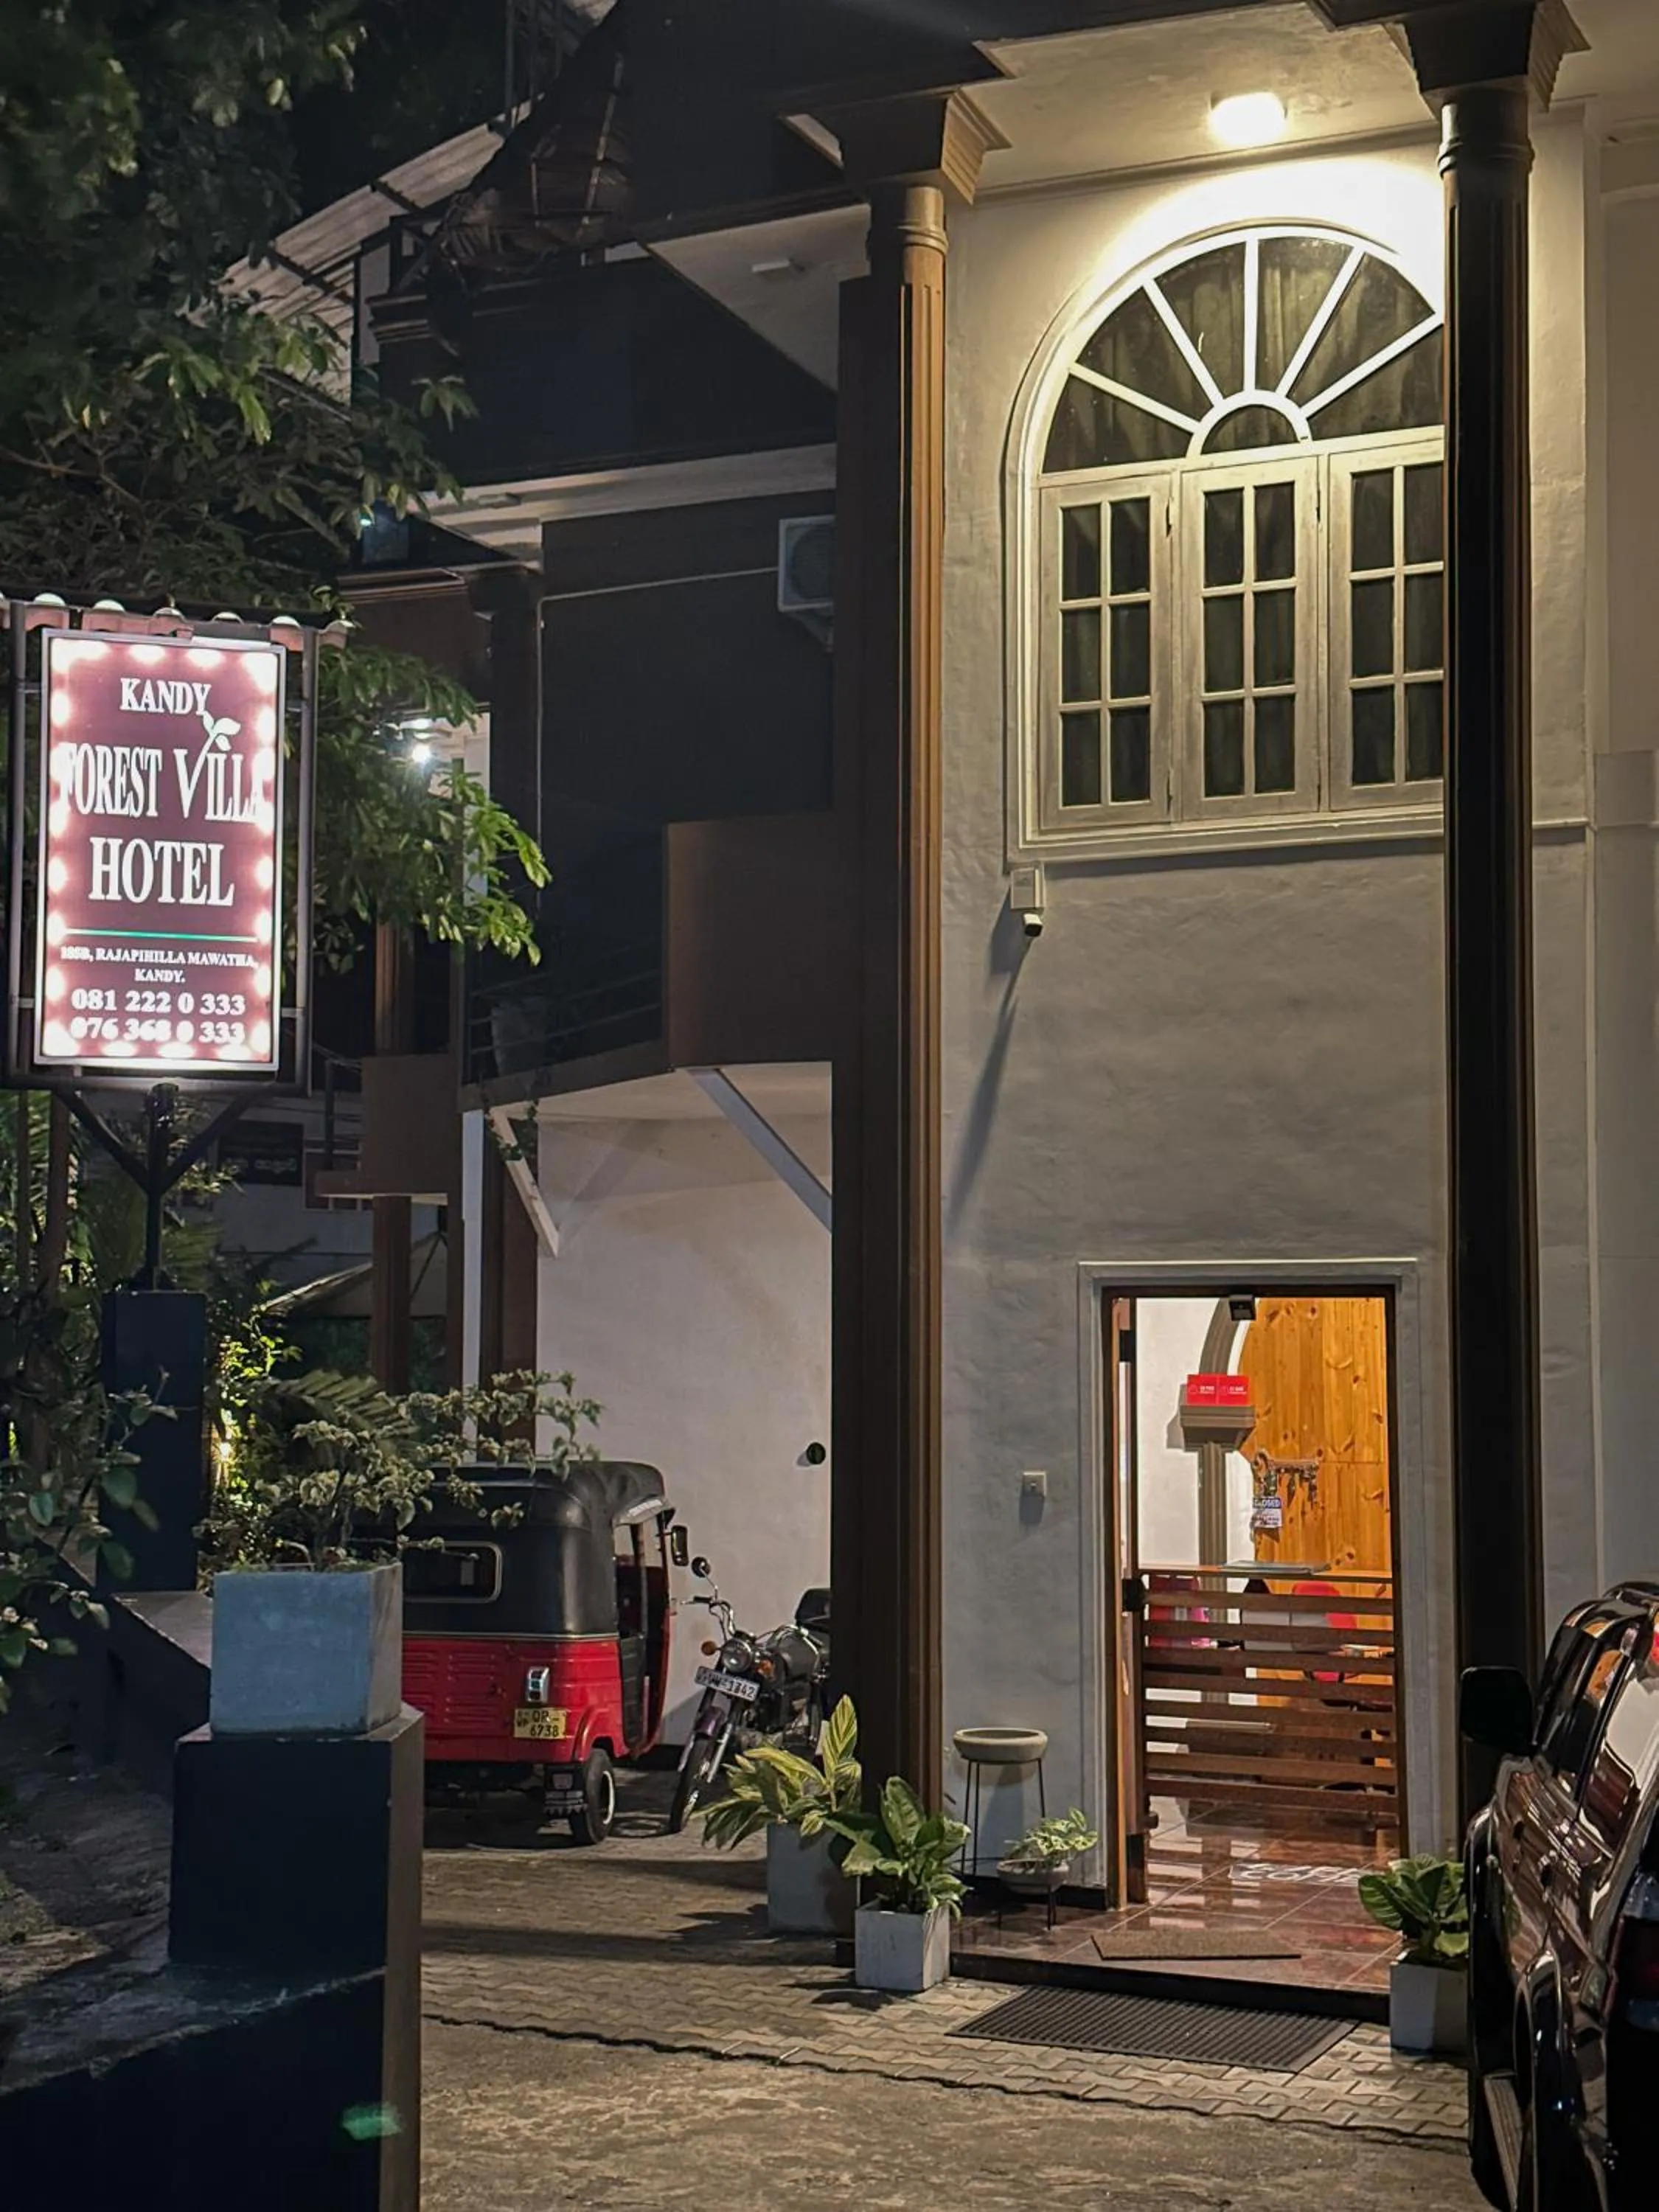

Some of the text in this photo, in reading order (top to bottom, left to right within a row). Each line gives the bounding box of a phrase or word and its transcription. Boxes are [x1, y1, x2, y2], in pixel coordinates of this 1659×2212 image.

[119, 678, 212, 714] KANDY
[58, 742, 162, 818] FOREST
[88, 837, 234, 906] HOTEL
[96, 947, 186, 964] RAJAPIHILLA
[134, 968, 186, 983] KANDY.
[72, 988, 246, 1015] 081 222 0 333
[71, 1017, 119, 1040] 076
[198, 1022, 245, 1044] 333
